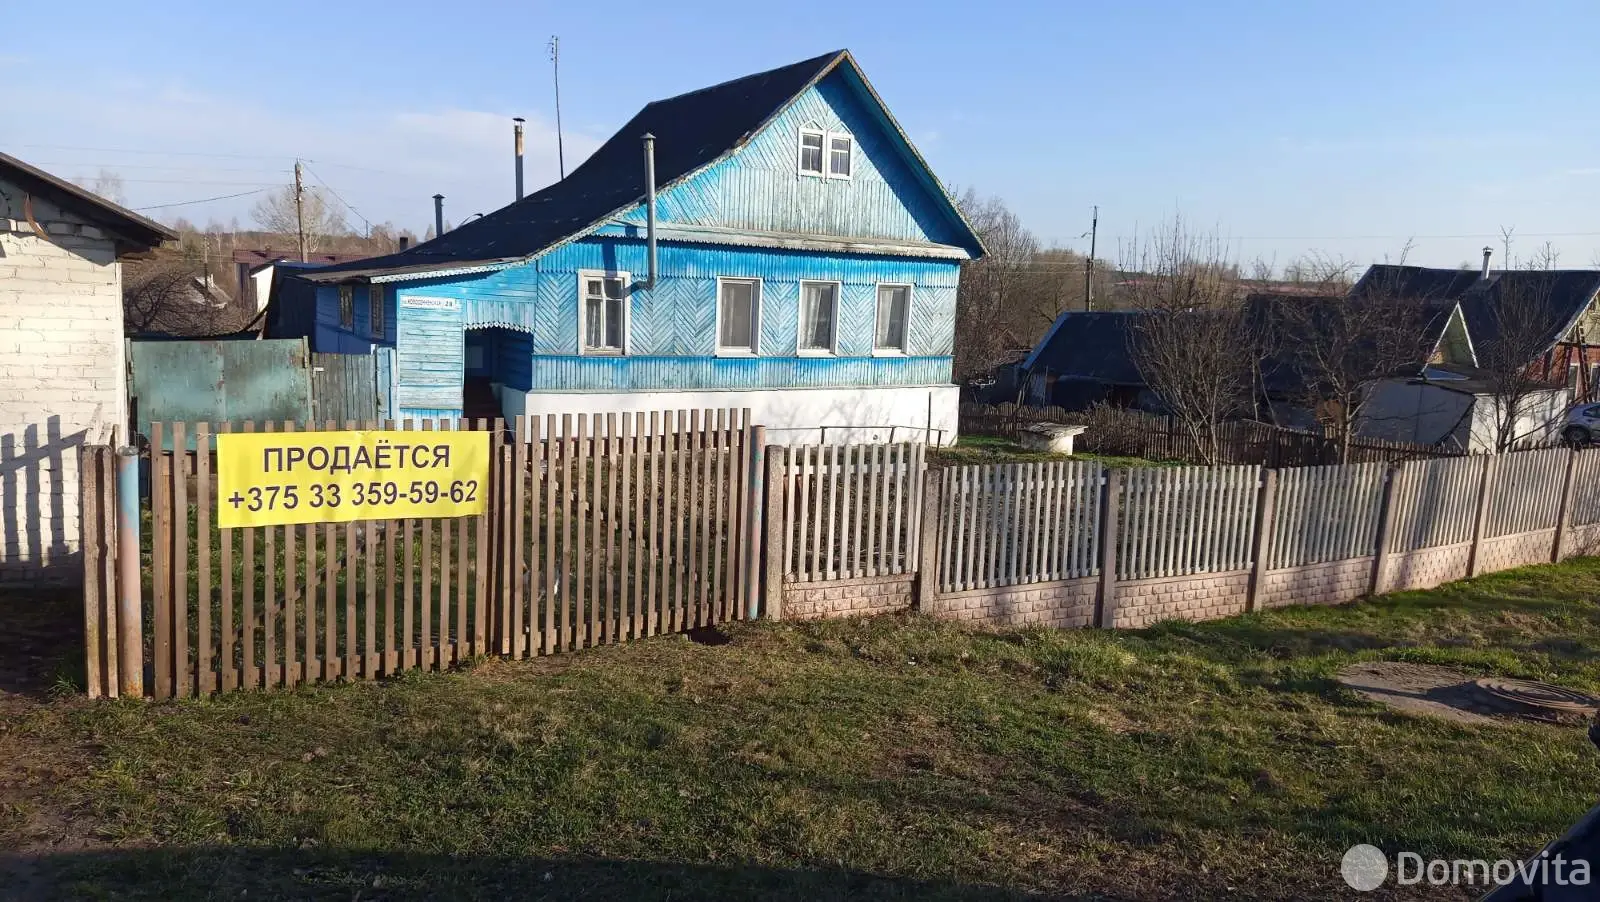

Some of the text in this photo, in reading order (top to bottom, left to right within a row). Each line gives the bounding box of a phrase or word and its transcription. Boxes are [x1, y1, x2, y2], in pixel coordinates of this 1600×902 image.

[263, 440, 450, 475] ПРОДАЁТСЯ
[228, 480, 478, 512] +375 33 359-59-62
